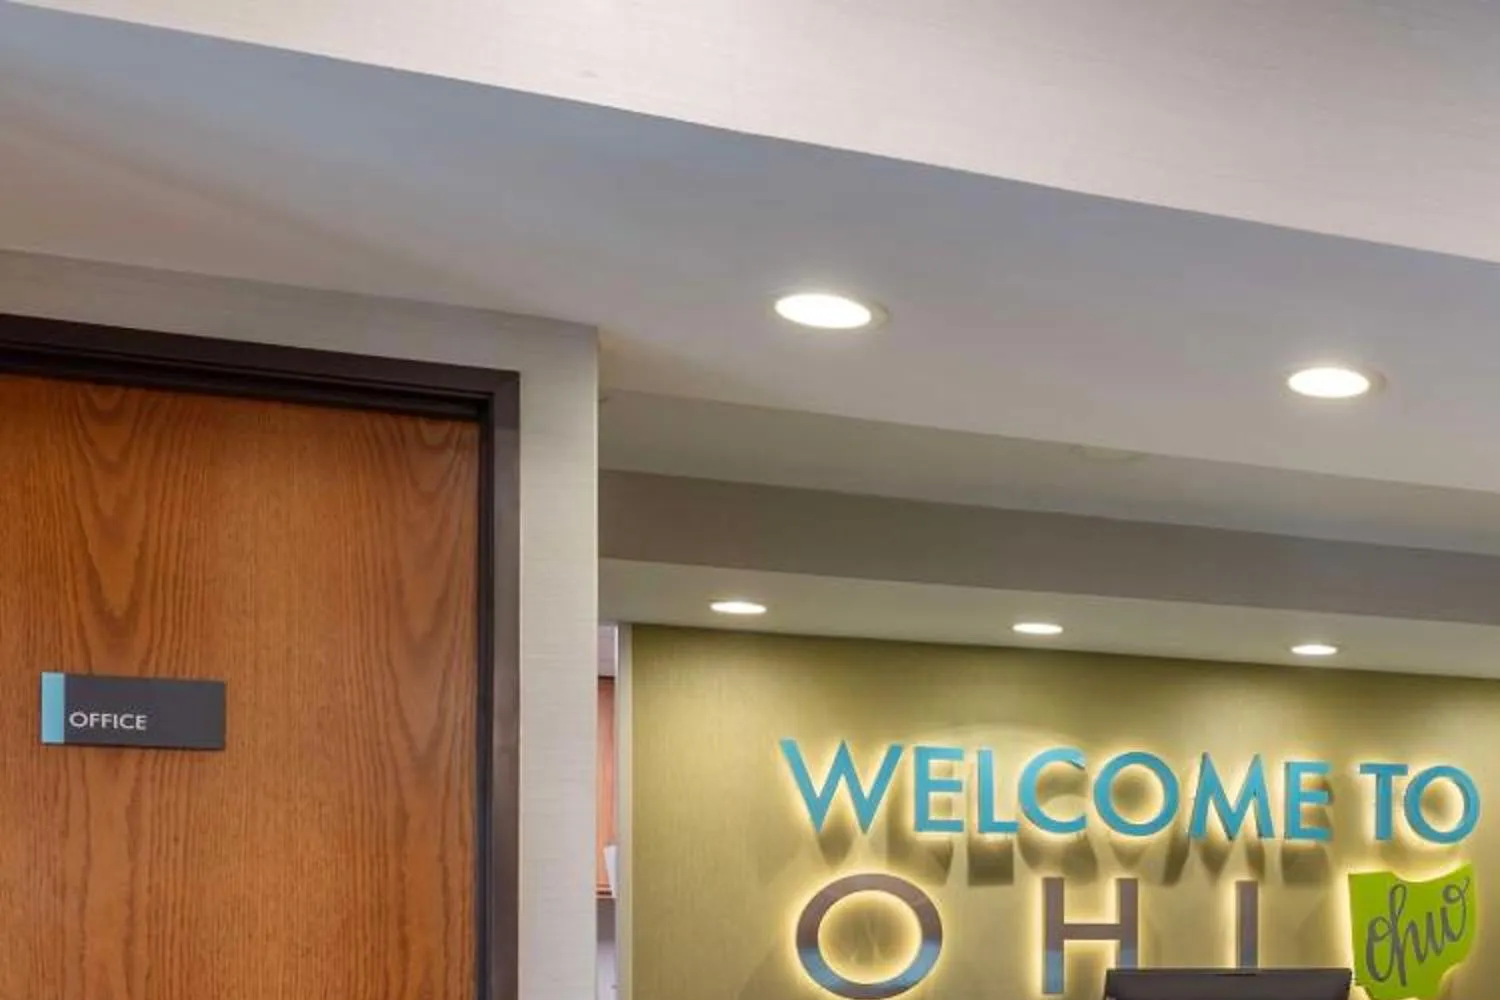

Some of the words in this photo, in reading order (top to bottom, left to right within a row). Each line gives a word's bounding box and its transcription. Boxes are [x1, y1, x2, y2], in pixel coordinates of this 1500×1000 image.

[69, 711, 148, 730] OFFICE
[779, 739, 1334, 843] WELCOME
[1359, 762, 1481, 845] TO
